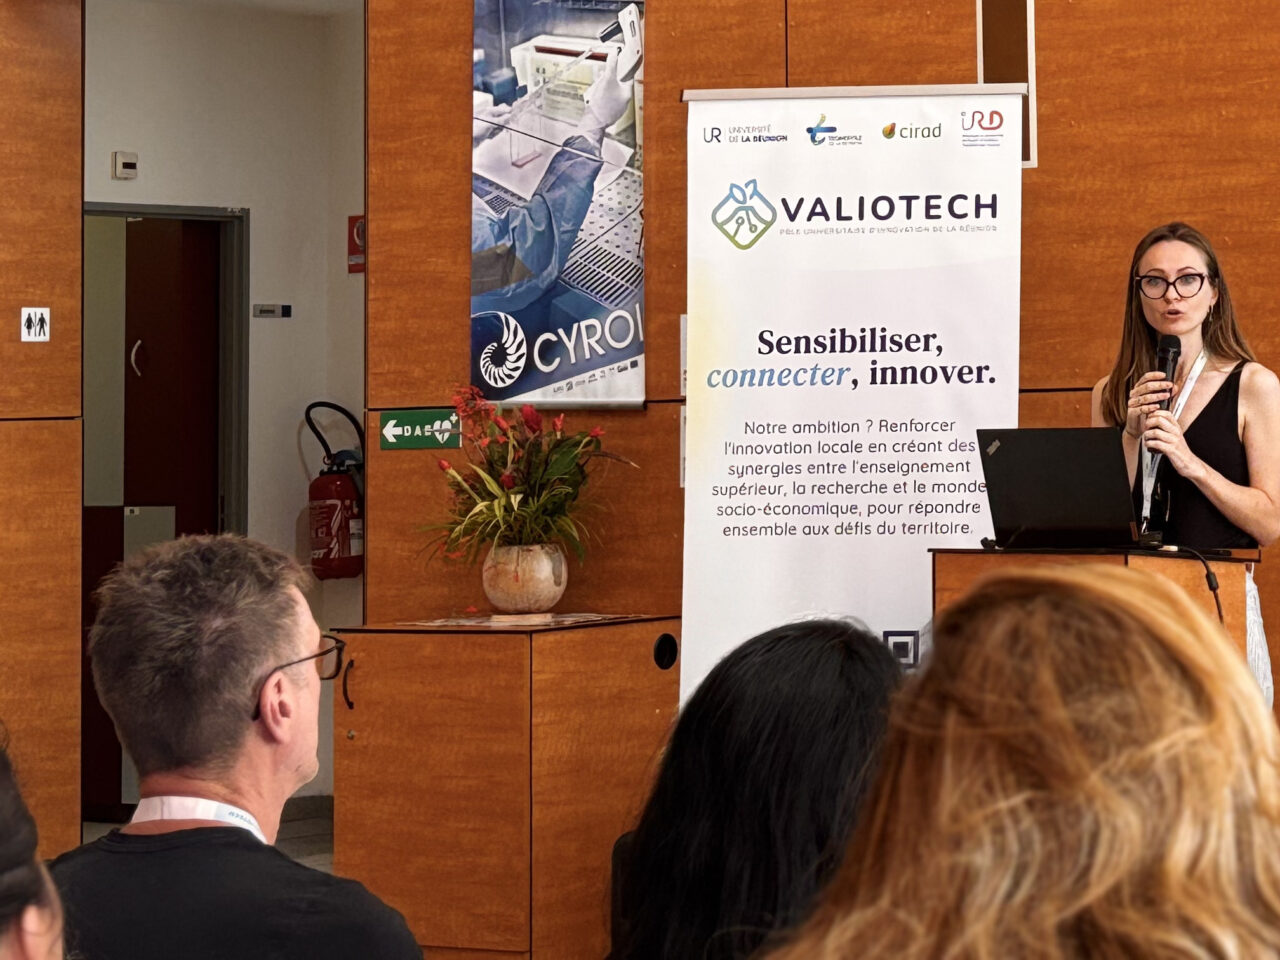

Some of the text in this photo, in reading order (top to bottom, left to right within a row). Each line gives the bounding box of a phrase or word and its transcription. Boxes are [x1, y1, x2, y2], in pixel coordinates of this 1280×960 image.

[900, 123, 942, 139] cirad
[780, 194, 998, 223] VALIOTECH
[533, 302, 644, 373] CYROI
[757, 327, 943, 357] Sensibiliser,
[707, 362, 859, 390] connecter,
[869, 359, 996, 386] innover.
[403, 424, 432, 437] DAE
[744, 418, 956, 435] Notre ambition ? Renforcer
[818, 440, 863, 454] locale
[868, 443, 887, 453] en
[892, 439, 943, 453] créant
[948, 439, 976, 453] des
[728, 458, 971, 479] synergies entre l'enseignement
[711, 479, 987, 499] supérieur, la recherche et le monde
[717, 500, 981, 518] socio-économique, pour répondre
[723, 520, 973, 537] ensemble aux défis du territoire.
